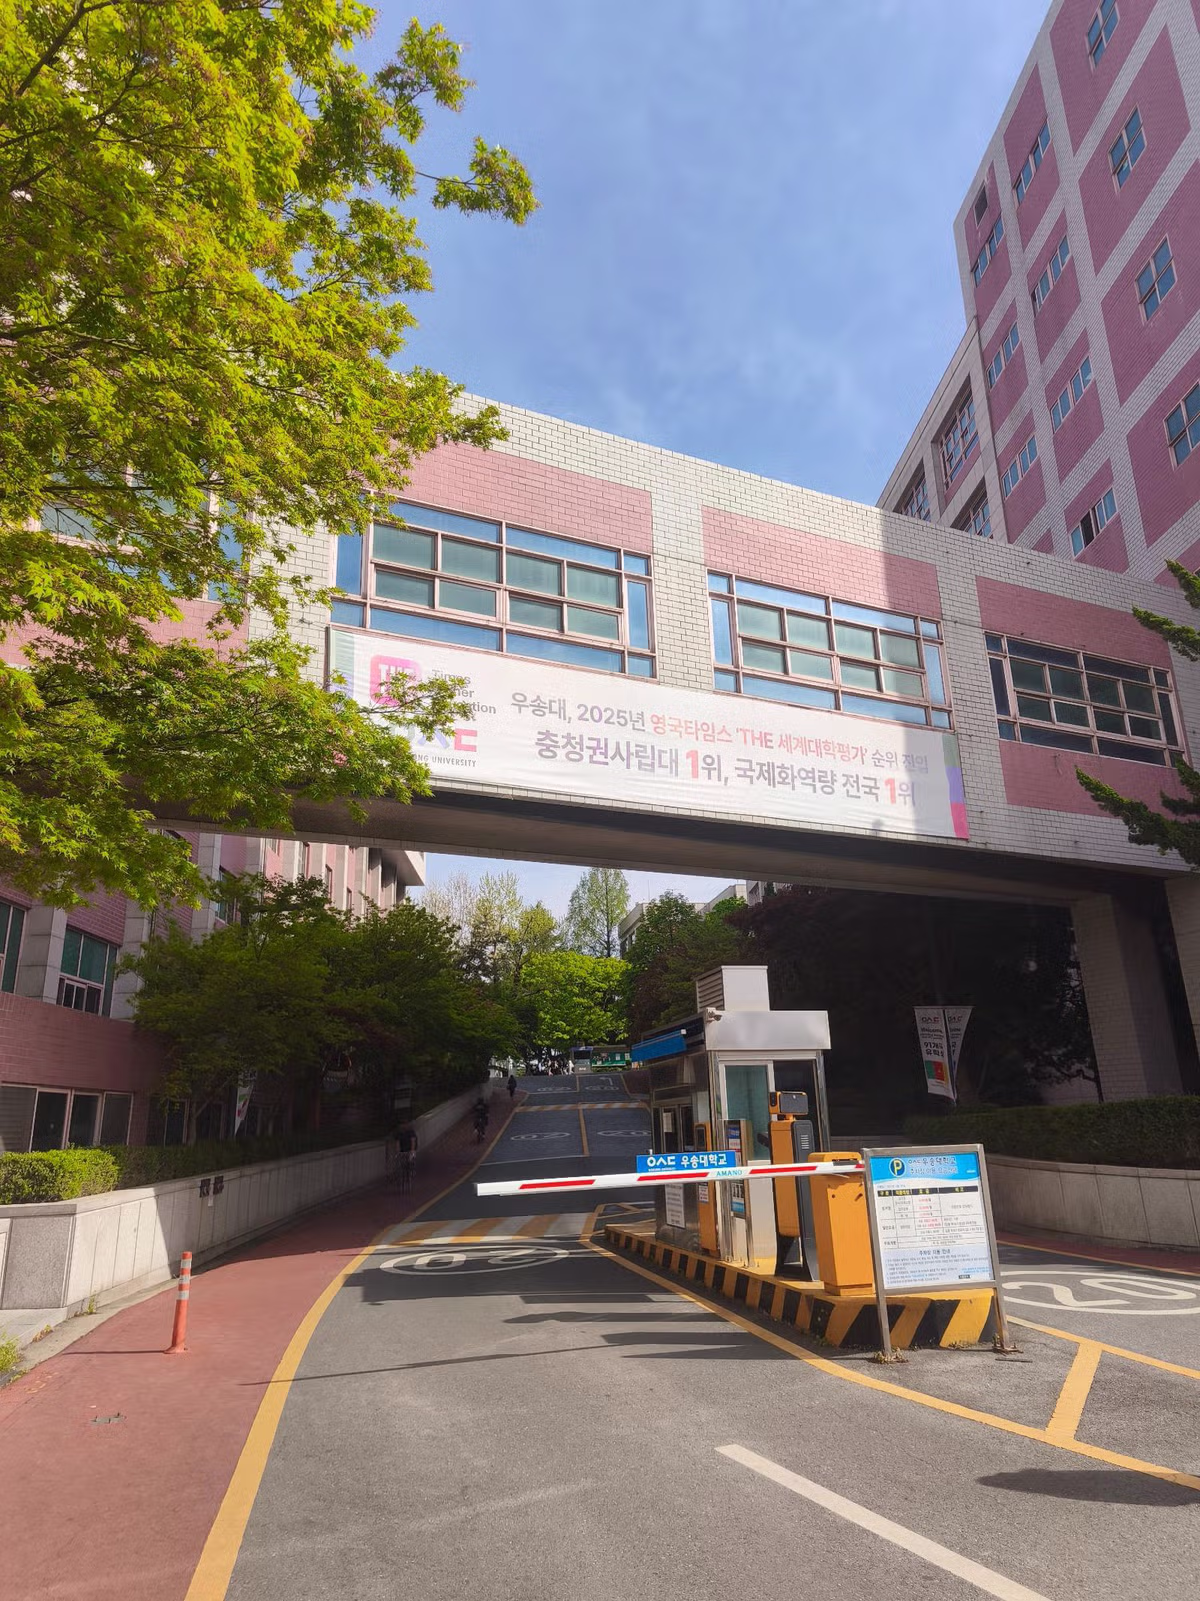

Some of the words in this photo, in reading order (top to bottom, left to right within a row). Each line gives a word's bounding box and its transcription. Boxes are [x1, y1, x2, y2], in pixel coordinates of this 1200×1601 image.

[510, 692, 572, 724] 우송대,
[577, 703, 646, 732] 2025년
[650, 714, 733, 743] 영국타임스
[871, 749, 898, 769] 순위
[432, 755, 477, 767] UNIVERSITY
[535, 729, 679, 777] 충청권사립대
[734, 757, 837, 795] 국제화역량
[842, 773, 880, 802] 전국
[884, 777, 916, 807] 1위
[681, 1153, 727, 1169] 우송대학교
[716, 1169, 743, 1178] AMANO
